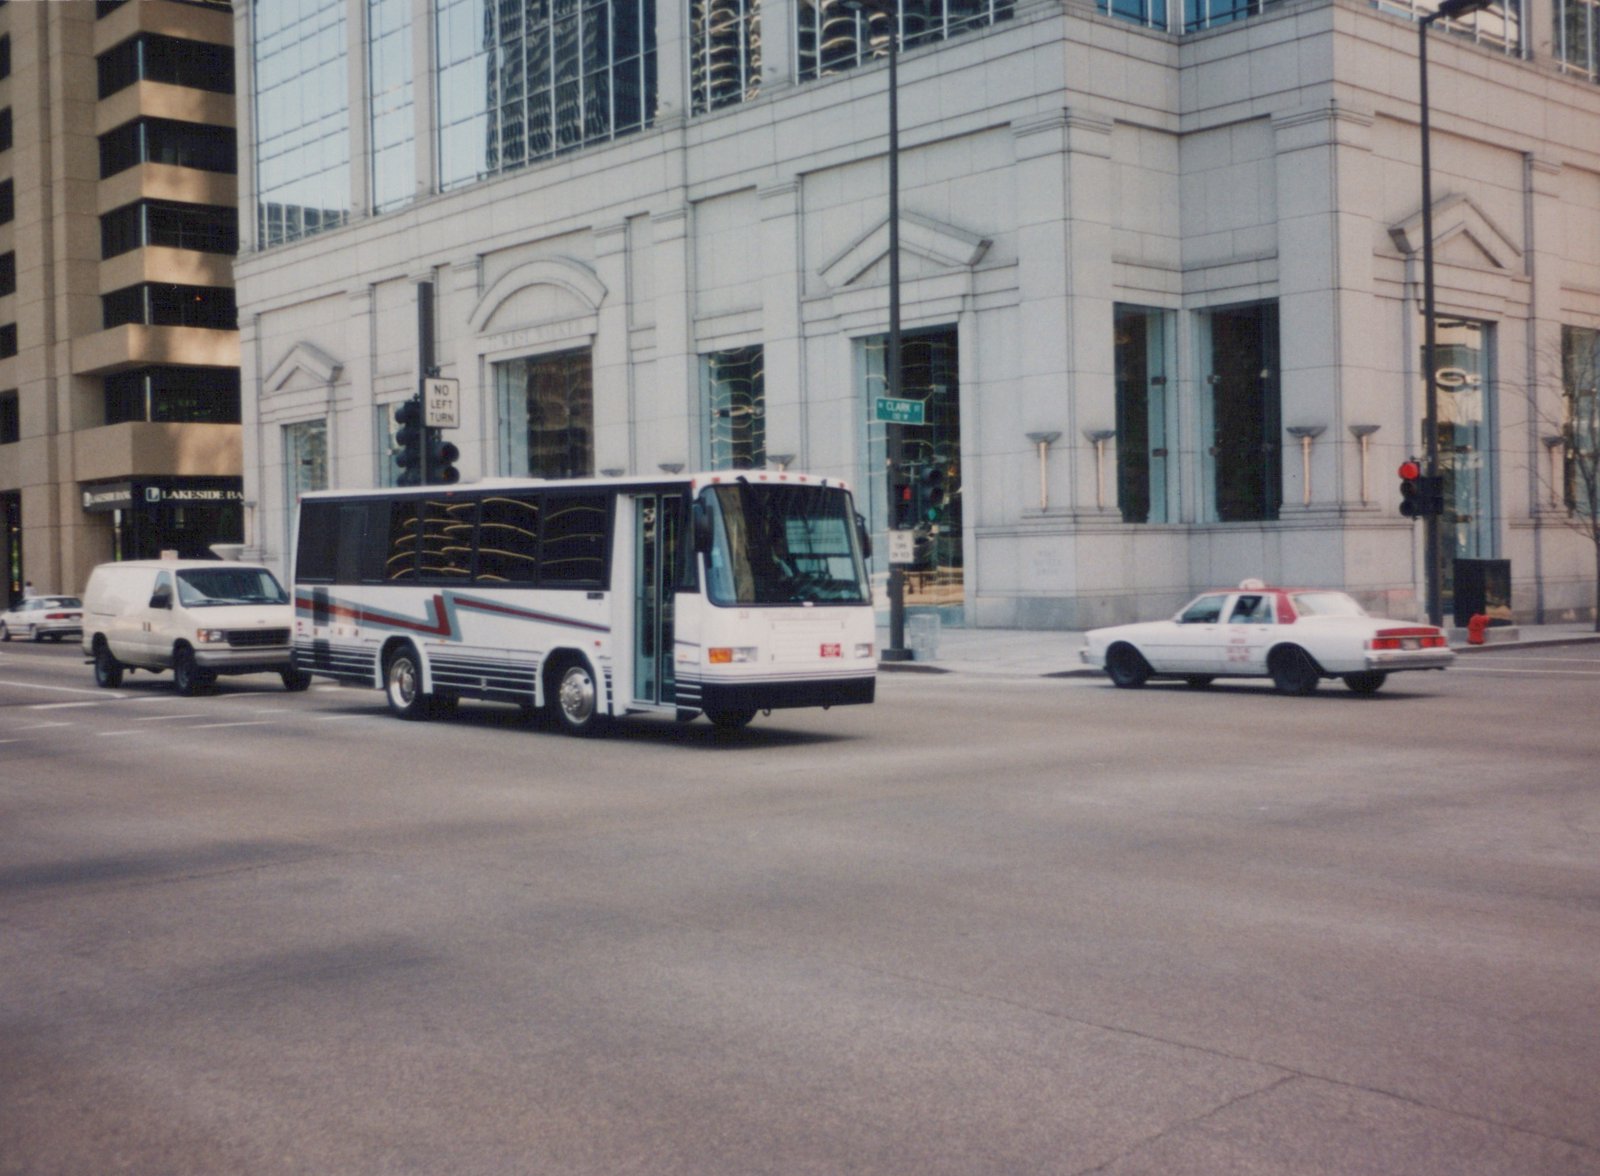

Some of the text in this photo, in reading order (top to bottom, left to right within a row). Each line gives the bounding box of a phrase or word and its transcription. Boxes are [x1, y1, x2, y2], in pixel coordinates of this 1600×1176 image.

[434, 384, 449, 396] NO
[430, 399, 453, 409] LEFT
[886, 401, 911, 413] CLARK
[429, 411, 455, 423] TURN
[162, 489, 244, 500] LAKESIDE BA
